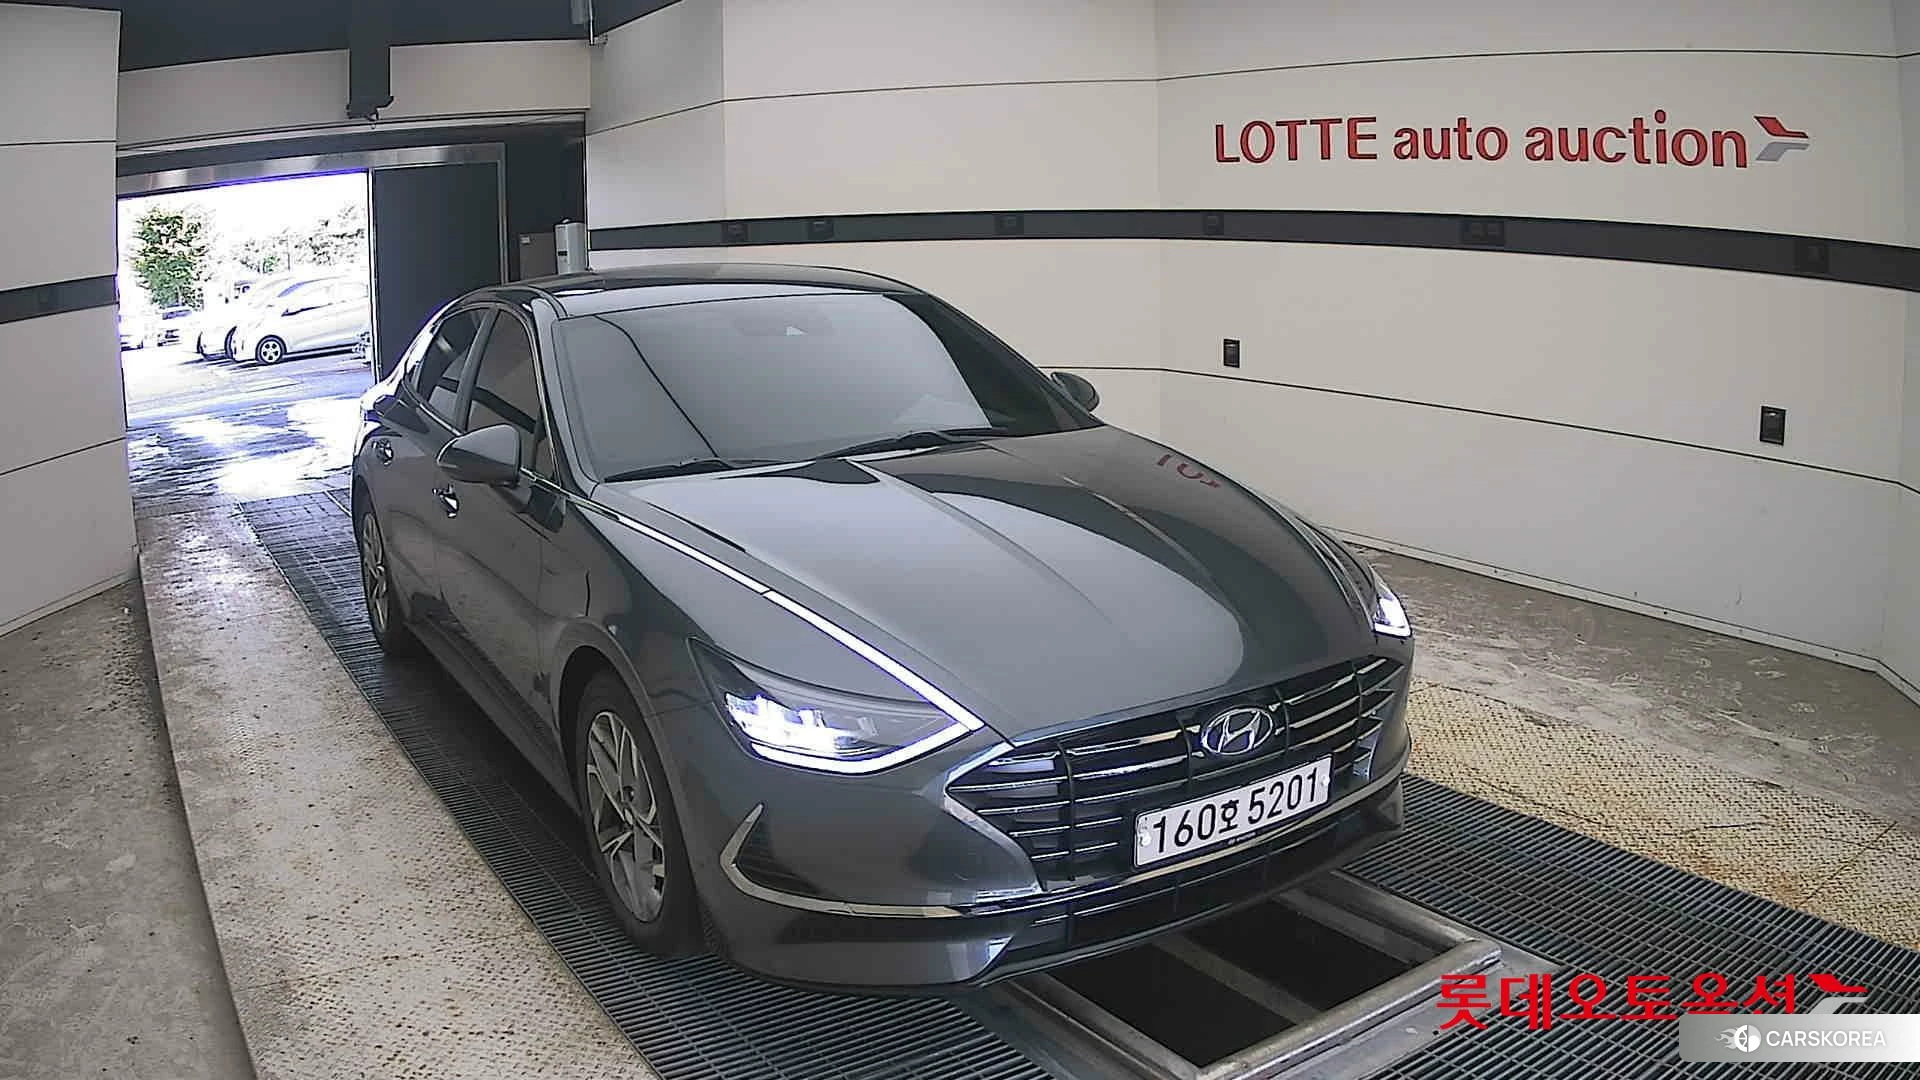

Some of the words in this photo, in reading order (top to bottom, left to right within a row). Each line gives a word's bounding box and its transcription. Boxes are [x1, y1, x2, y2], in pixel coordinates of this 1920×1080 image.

[1214, 116, 1378, 164] LOTTE
[1393, 117, 1509, 161] auto
[1524, 109, 1748, 168] auction
[1153, 799, 1239, 853] 160호
[1247, 767, 1318, 825] 5201
